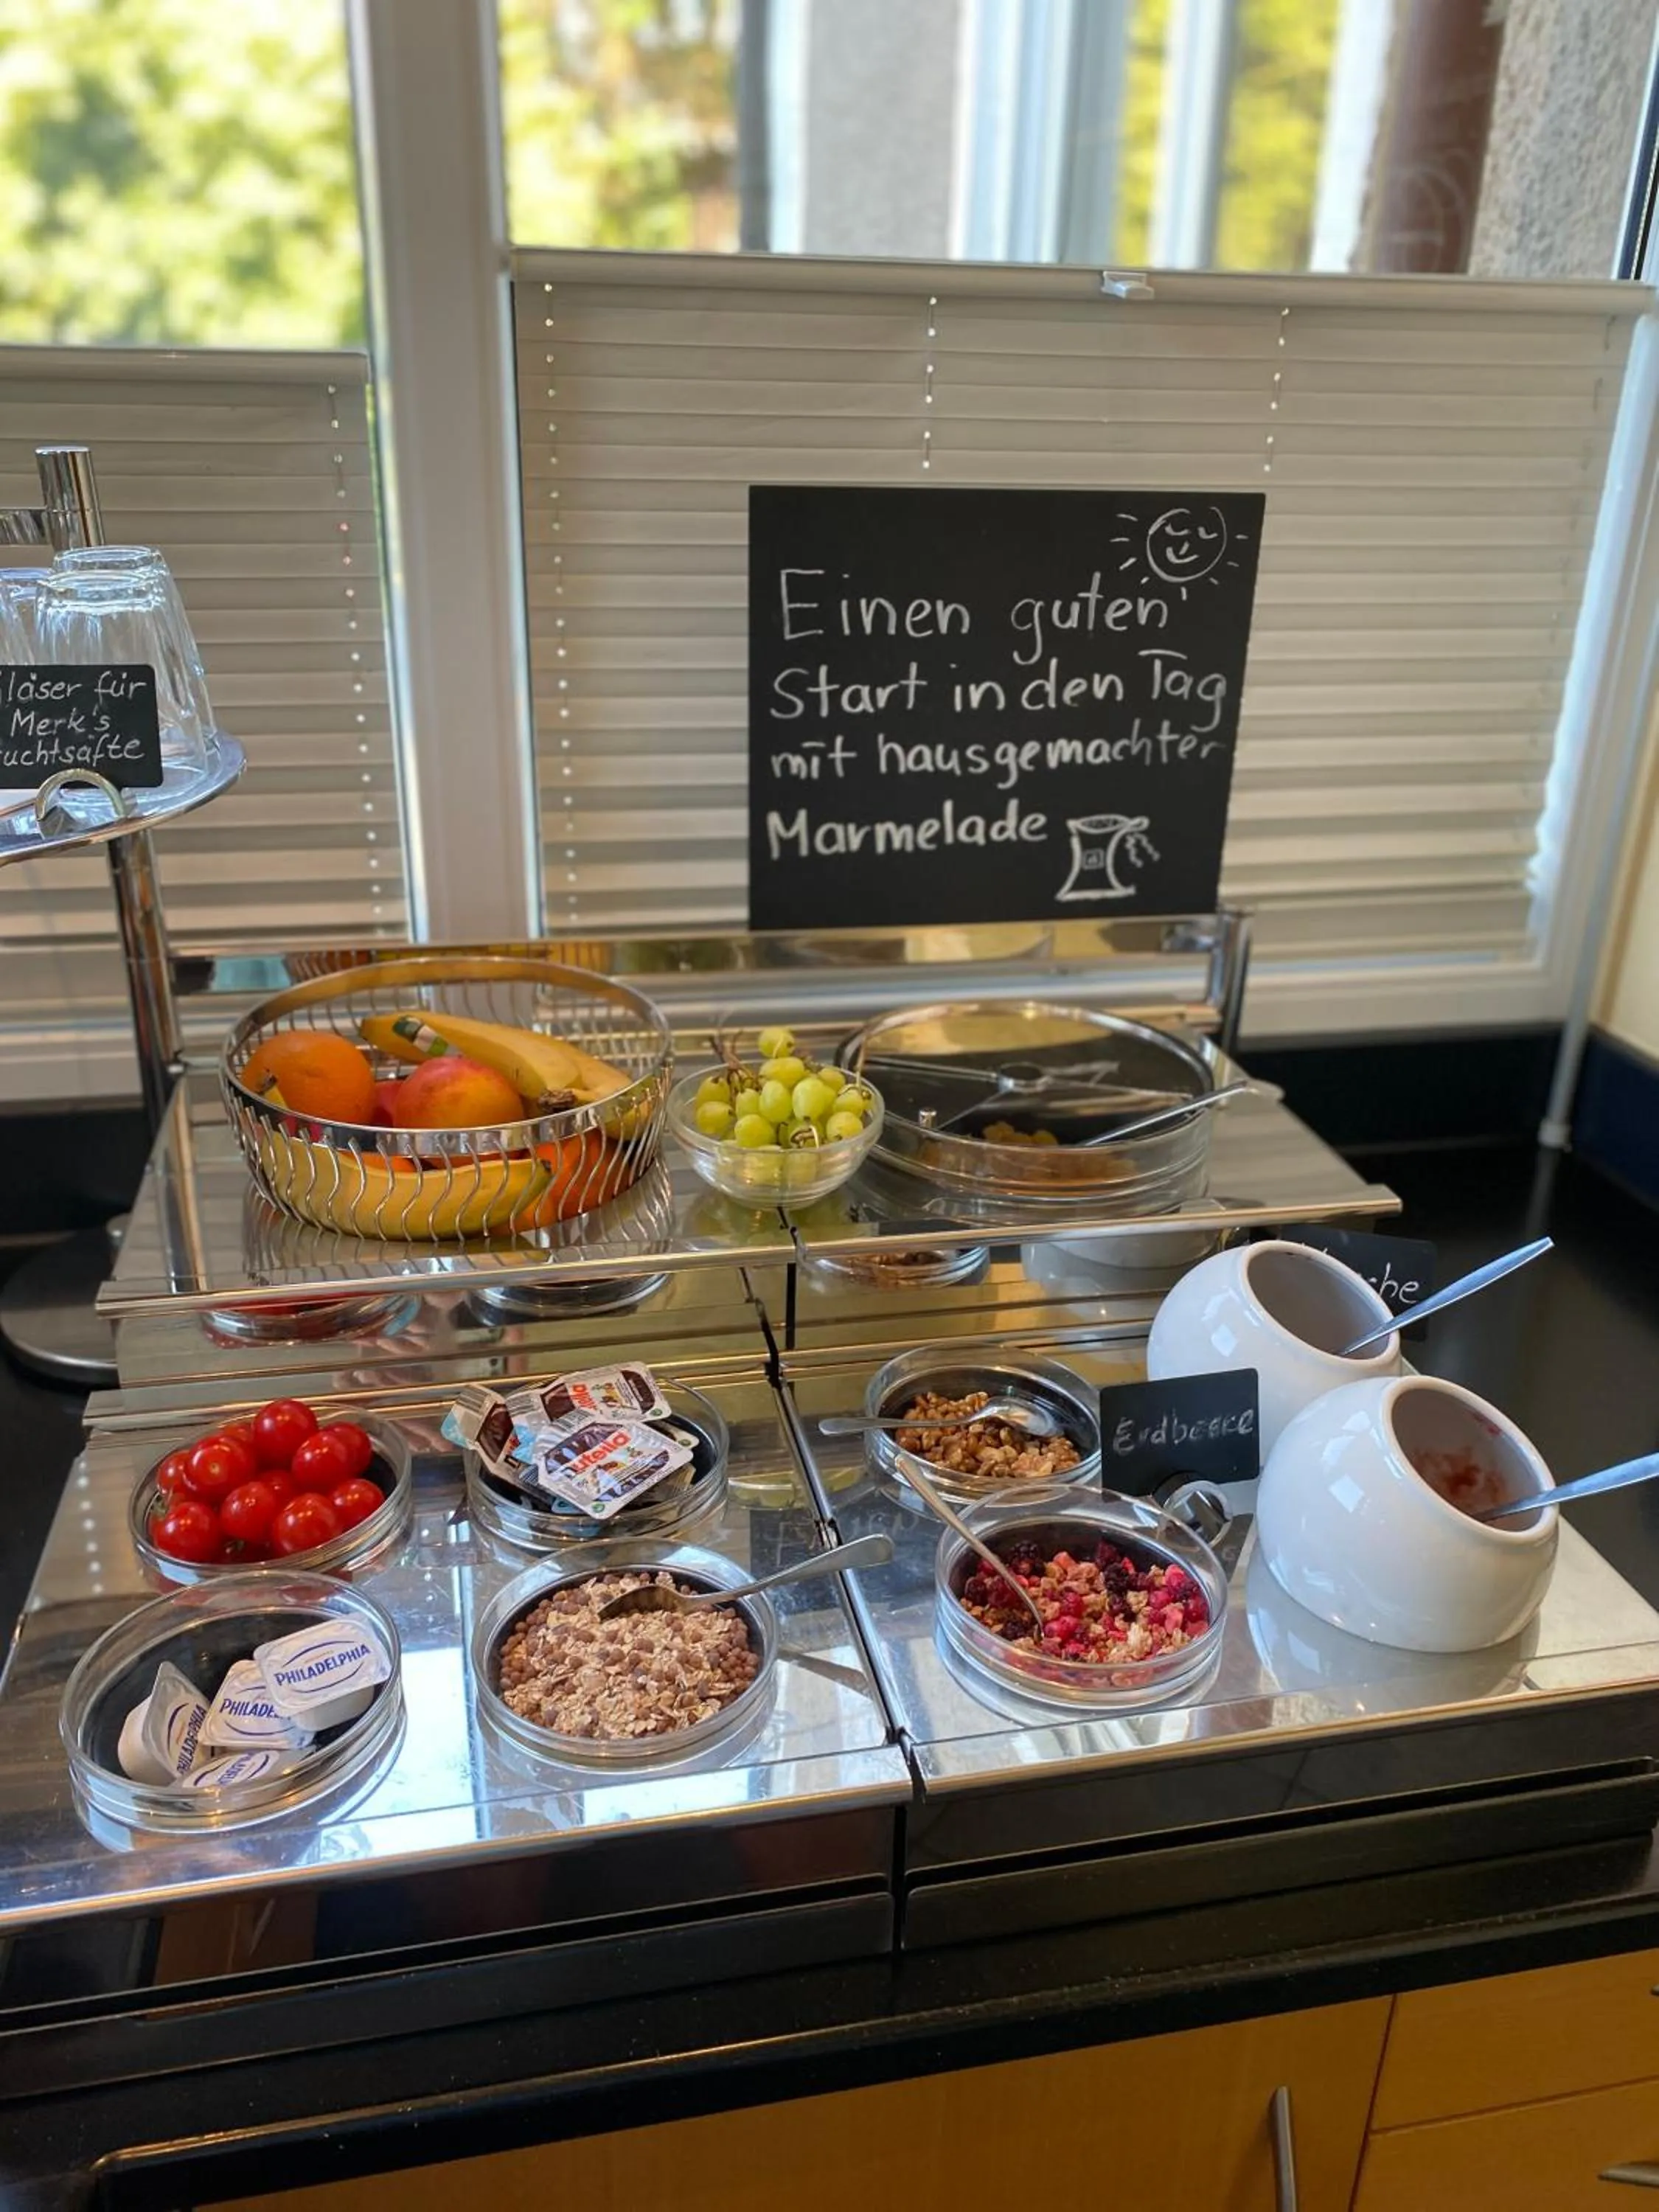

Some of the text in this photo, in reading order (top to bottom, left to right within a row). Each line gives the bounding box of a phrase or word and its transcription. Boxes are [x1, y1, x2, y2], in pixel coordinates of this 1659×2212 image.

[780, 568, 1168, 665] Einen guten
[0, 670, 147, 704] läser für
[770, 648, 1227, 731] Start in den Tag
[11, 704, 111, 737] Merk's
[0, 734, 146, 767] uchtsäfte
[771, 718, 1222, 790] mit hausgemachter
[766, 798, 1048, 860] Marmelade
[274, 1644, 371, 1686] PHILADELPHIA
